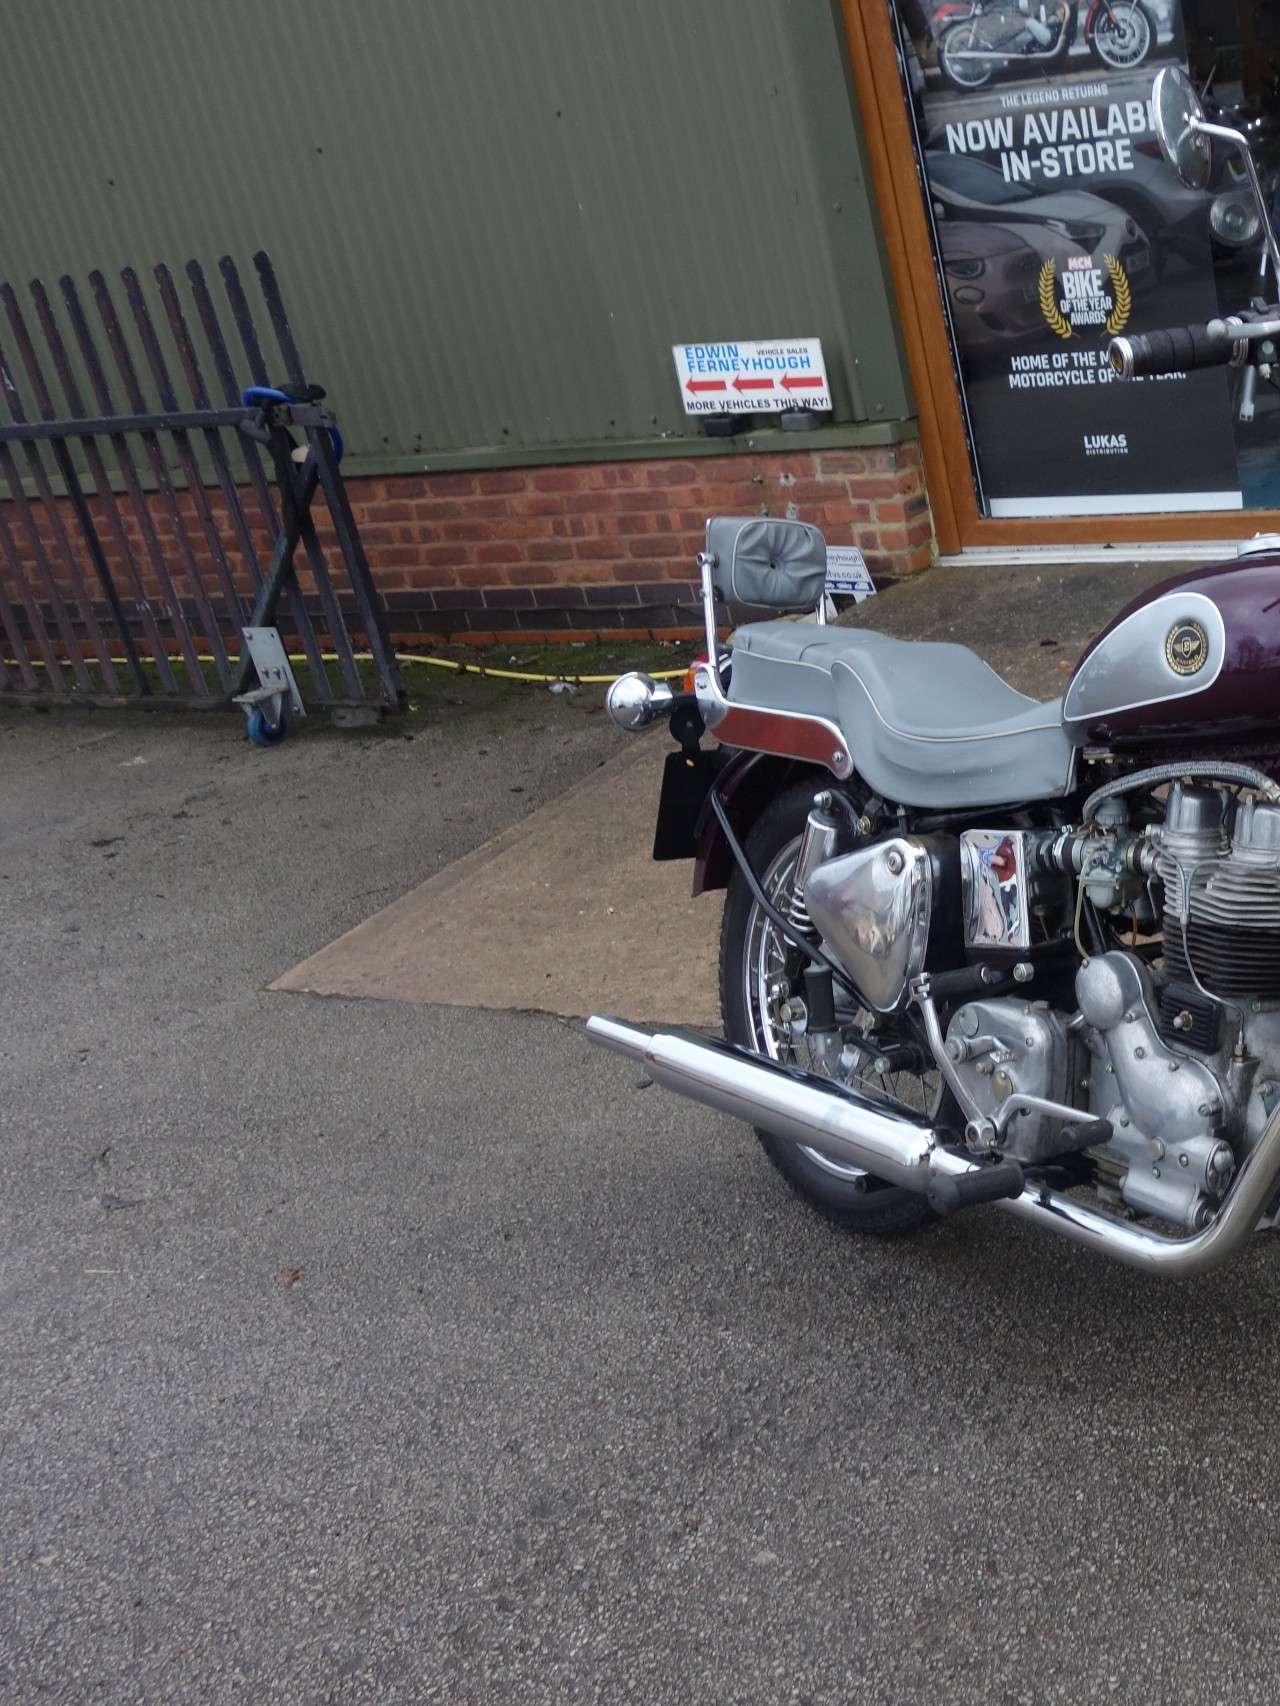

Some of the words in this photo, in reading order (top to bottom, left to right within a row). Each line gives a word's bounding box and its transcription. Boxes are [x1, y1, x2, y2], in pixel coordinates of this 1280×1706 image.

[1001, 96, 1019, 108] THE
[1021, 90, 1059, 105] LEGEND
[1061, 83, 1109, 101] RETURNS
[945, 116, 1014, 154] NOW
[1023, 99, 1157, 146] AVAILAB
[1000, 138, 1134, 183] IN-STORE
[1067, 255, 1093, 271] MCN
[1062, 269, 1105, 299] BIKE
[1060, 299, 1071, 313] OF
[1071, 298, 1089, 312] THE
[1089, 296, 1113, 310] YEAR
[1070, 310, 1107, 326] AWARDS
[684, 344, 739, 360] EDWIN
[687, 356, 811, 373] FERNEYHOUGH
[1011, 354, 1050, 371] HOME
[1052, 353, 1069, 368] OF
[1070, 351, 1097, 367] THE
[1008, 370, 1096, 389] MOTORCYCLE
[1099, 368, 1115, 384] OF
[687, 400, 716, 410] MORE
[719, 399, 771, 410] VEHICLES
[774, 398, 798, 409] THIS
[799, 397, 829, 409] WAY!
[1083, 434, 1128, 449] LUKAS
